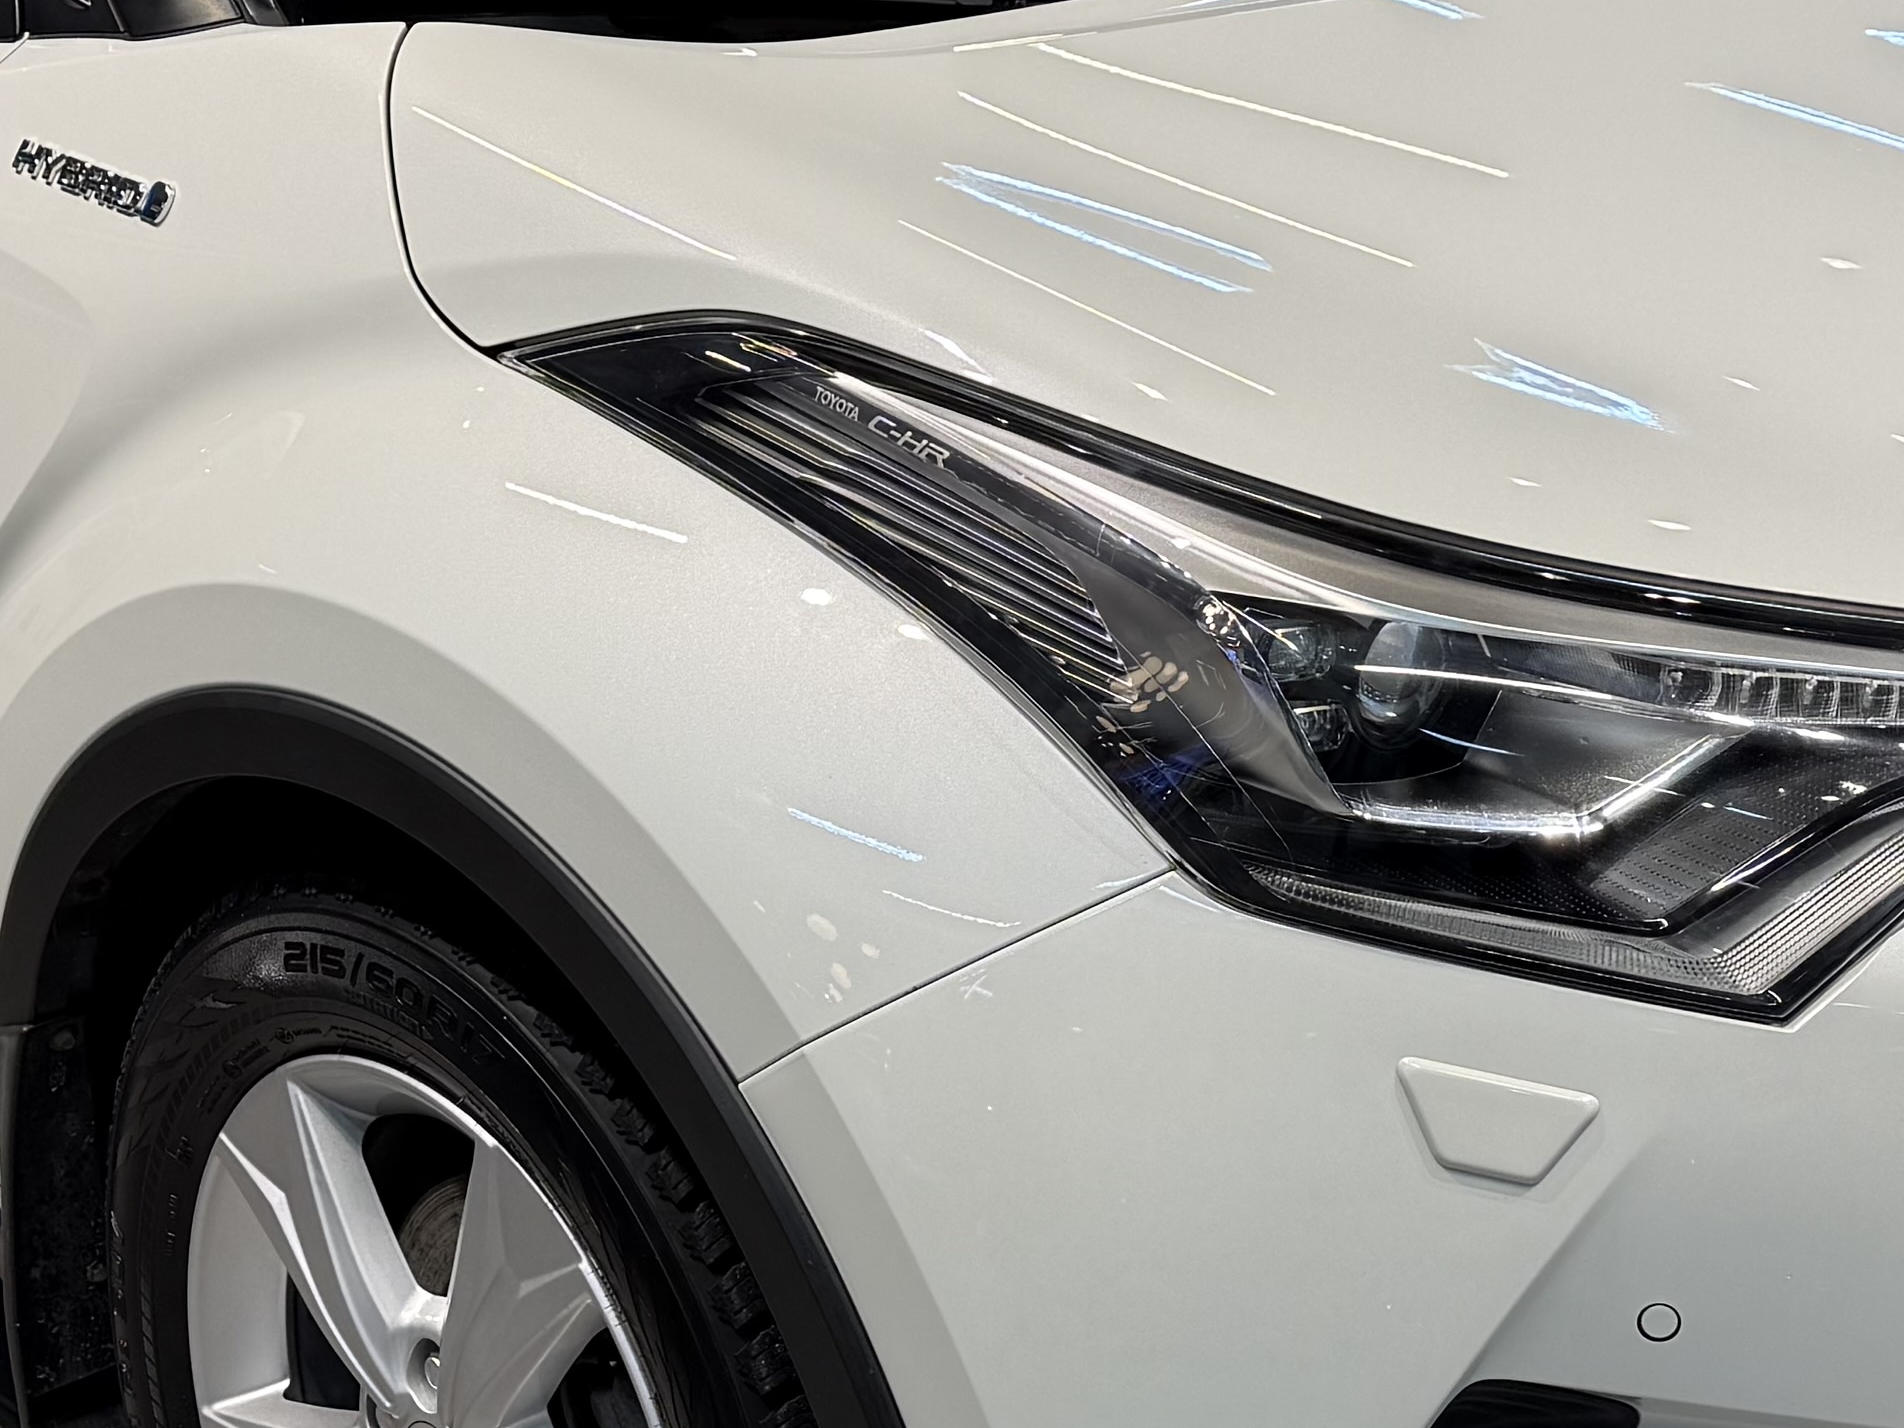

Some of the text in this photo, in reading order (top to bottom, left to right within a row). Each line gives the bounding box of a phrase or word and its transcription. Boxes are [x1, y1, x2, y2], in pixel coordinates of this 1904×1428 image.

[12, 139, 145, 217] HYBRID
[814, 386, 951, 468] TOYOTA C-HR
